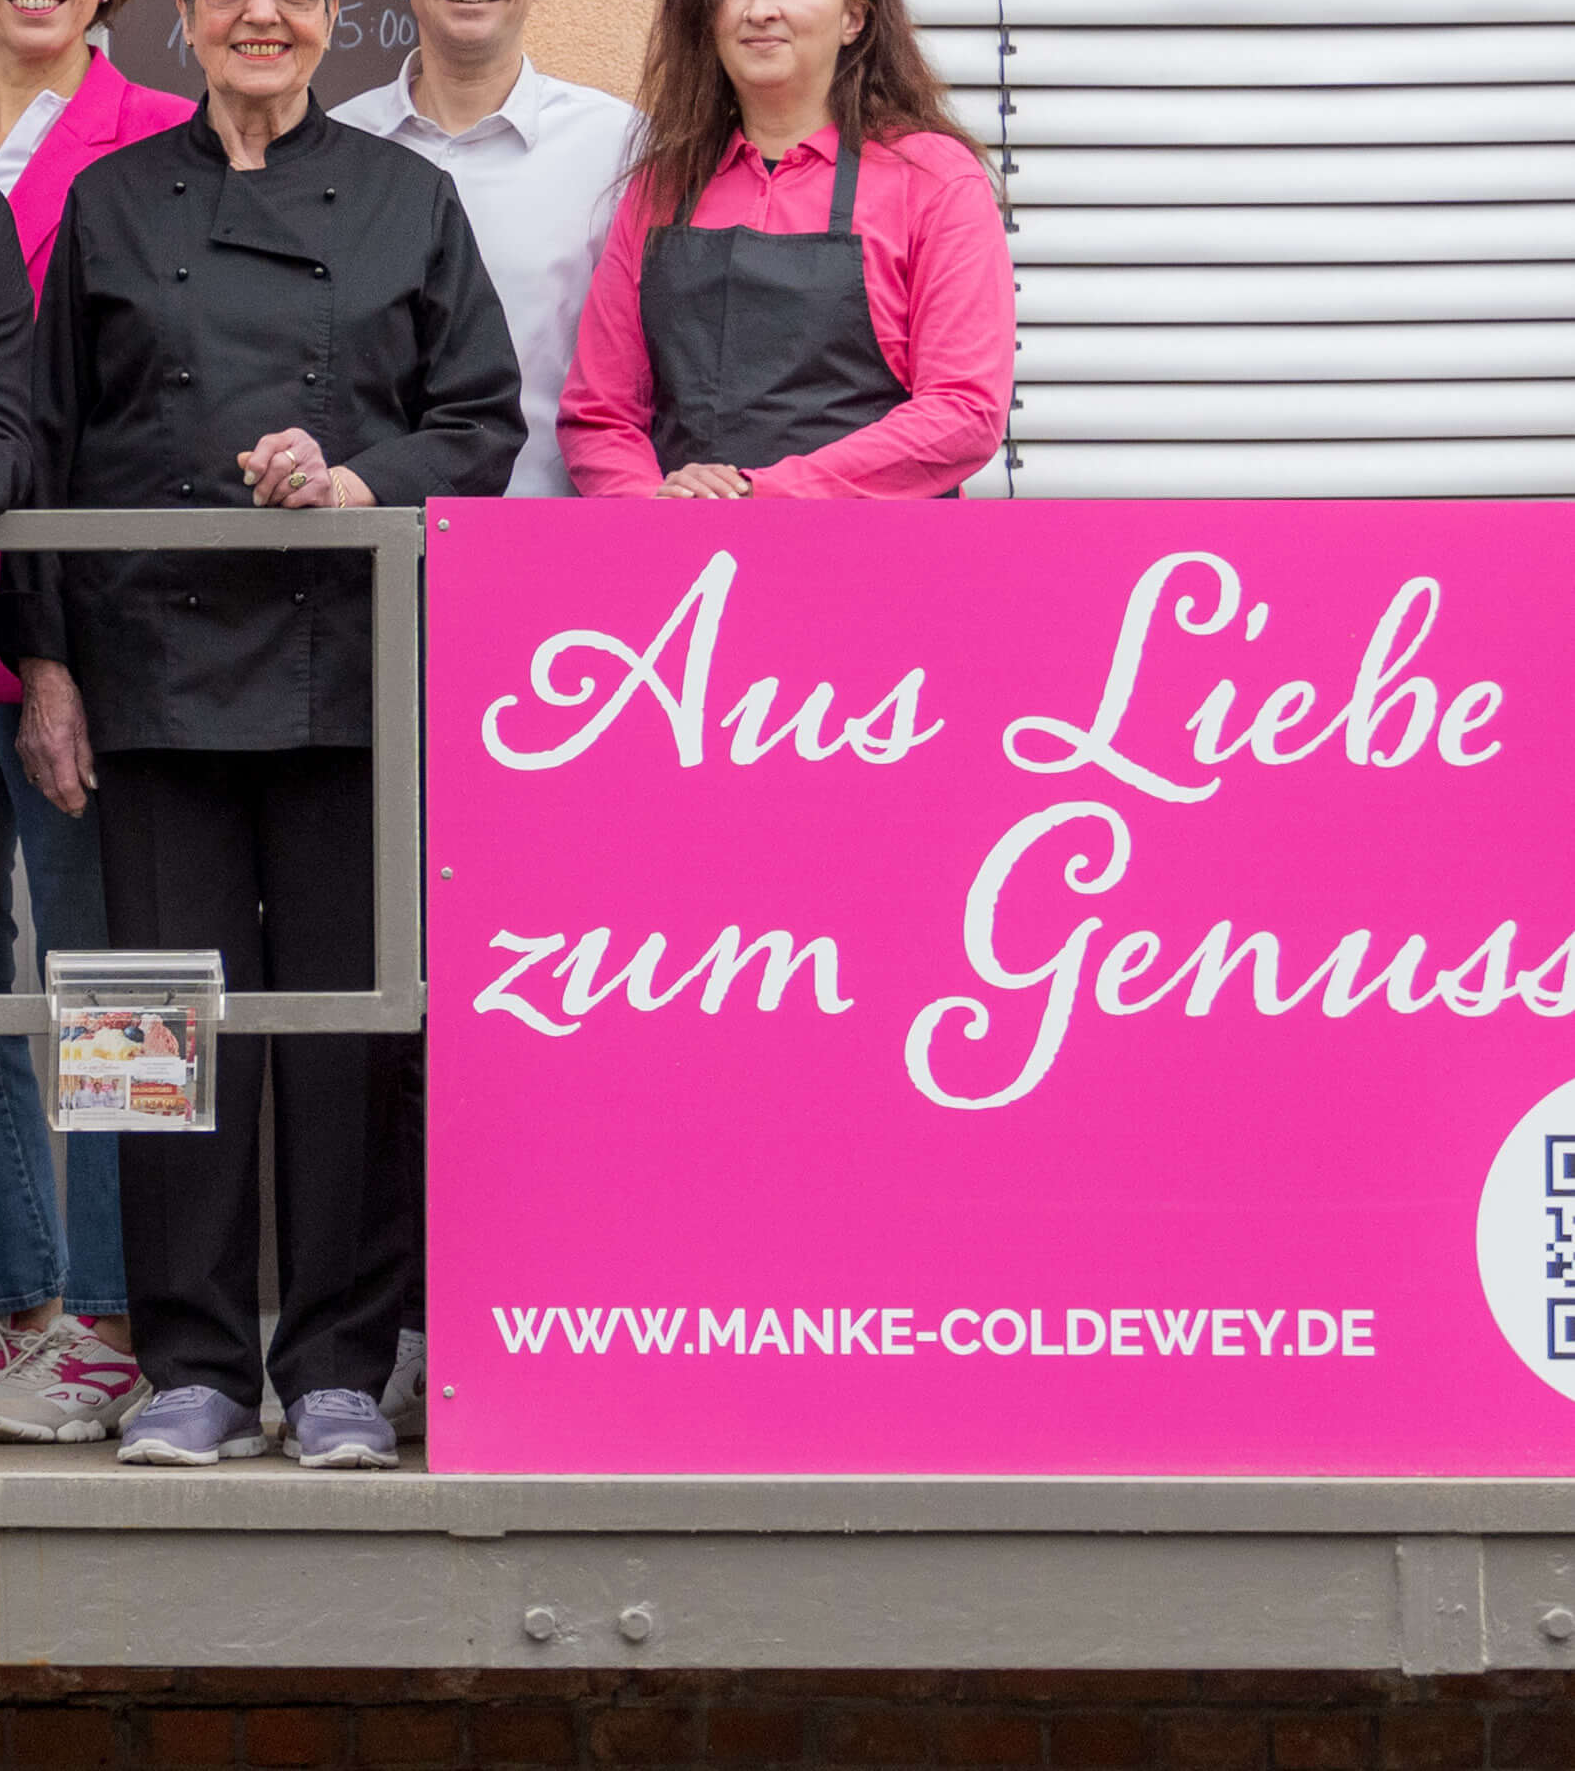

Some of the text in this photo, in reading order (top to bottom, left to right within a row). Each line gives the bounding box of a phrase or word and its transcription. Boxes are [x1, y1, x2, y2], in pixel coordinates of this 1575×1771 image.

[481, 550, 1504, 804] Aus Liebe
[472, 800, 1575, 1110] zum Genuss
[491, 1307, 1376, 1358] WWW.MANKE-COLDEWEY.DE
